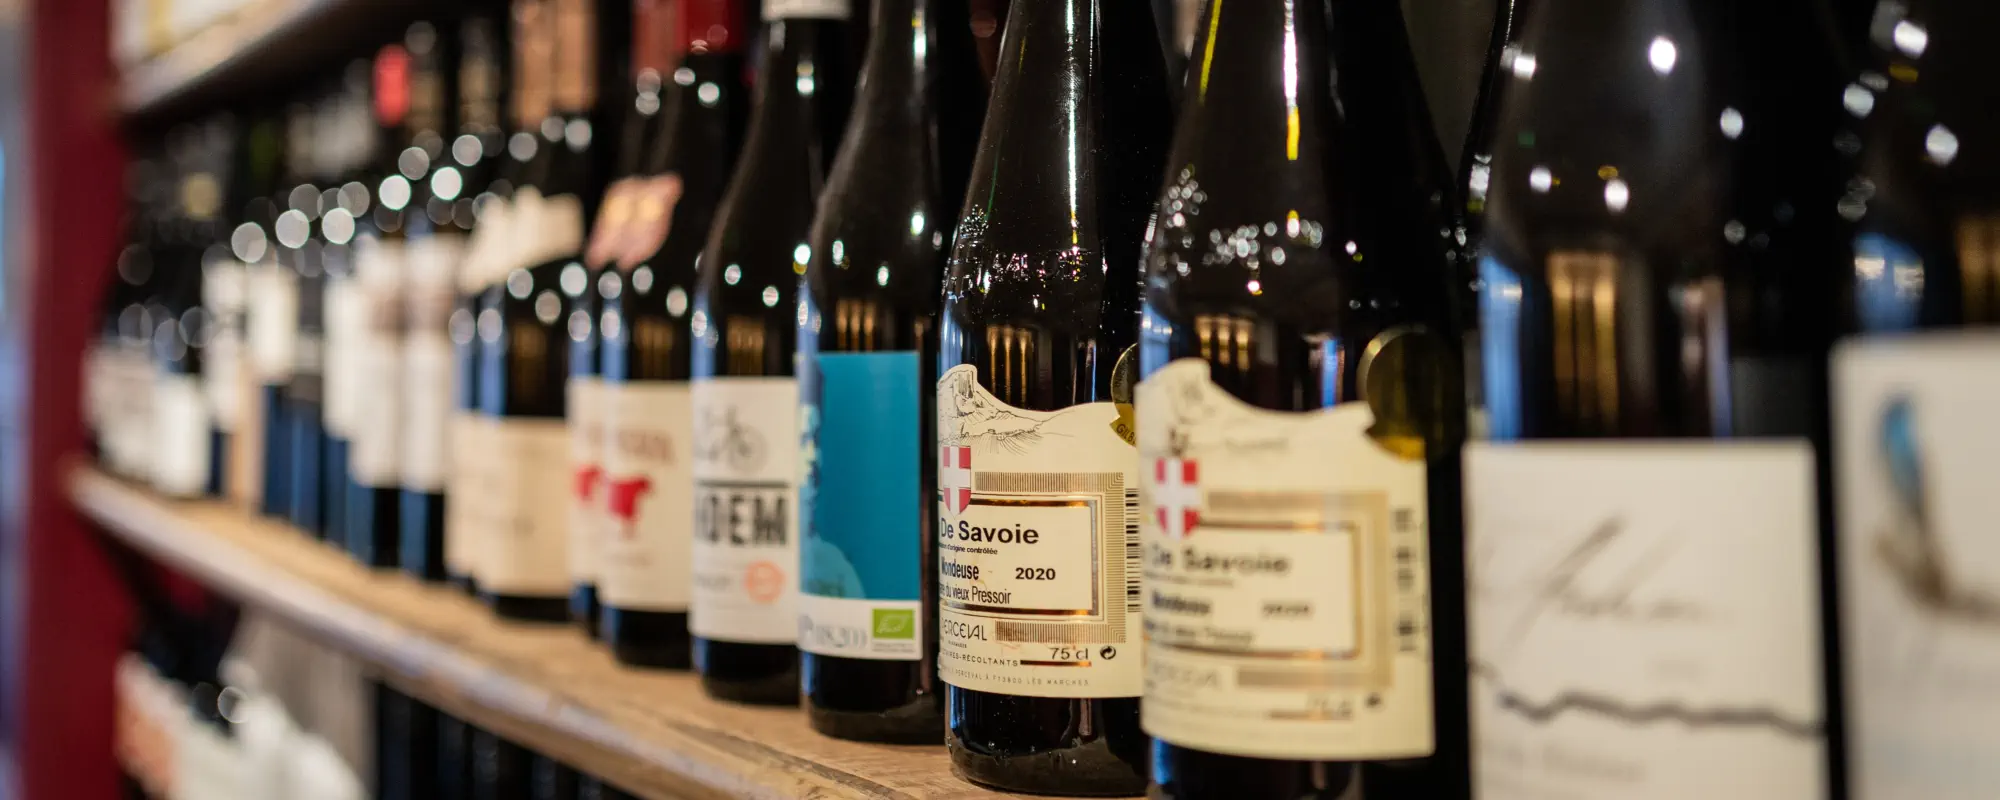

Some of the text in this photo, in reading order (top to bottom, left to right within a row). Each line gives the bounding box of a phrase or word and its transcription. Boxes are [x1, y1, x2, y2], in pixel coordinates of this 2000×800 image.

[941, 517, 1039, 544] De Savoie
[1015, 567, 1056, 580] 2020
[952, 584, 970, 601] vieux
[971, 585, 1012, 604] Pressoir
[1049, 647, 1089, 660] 75 cl
